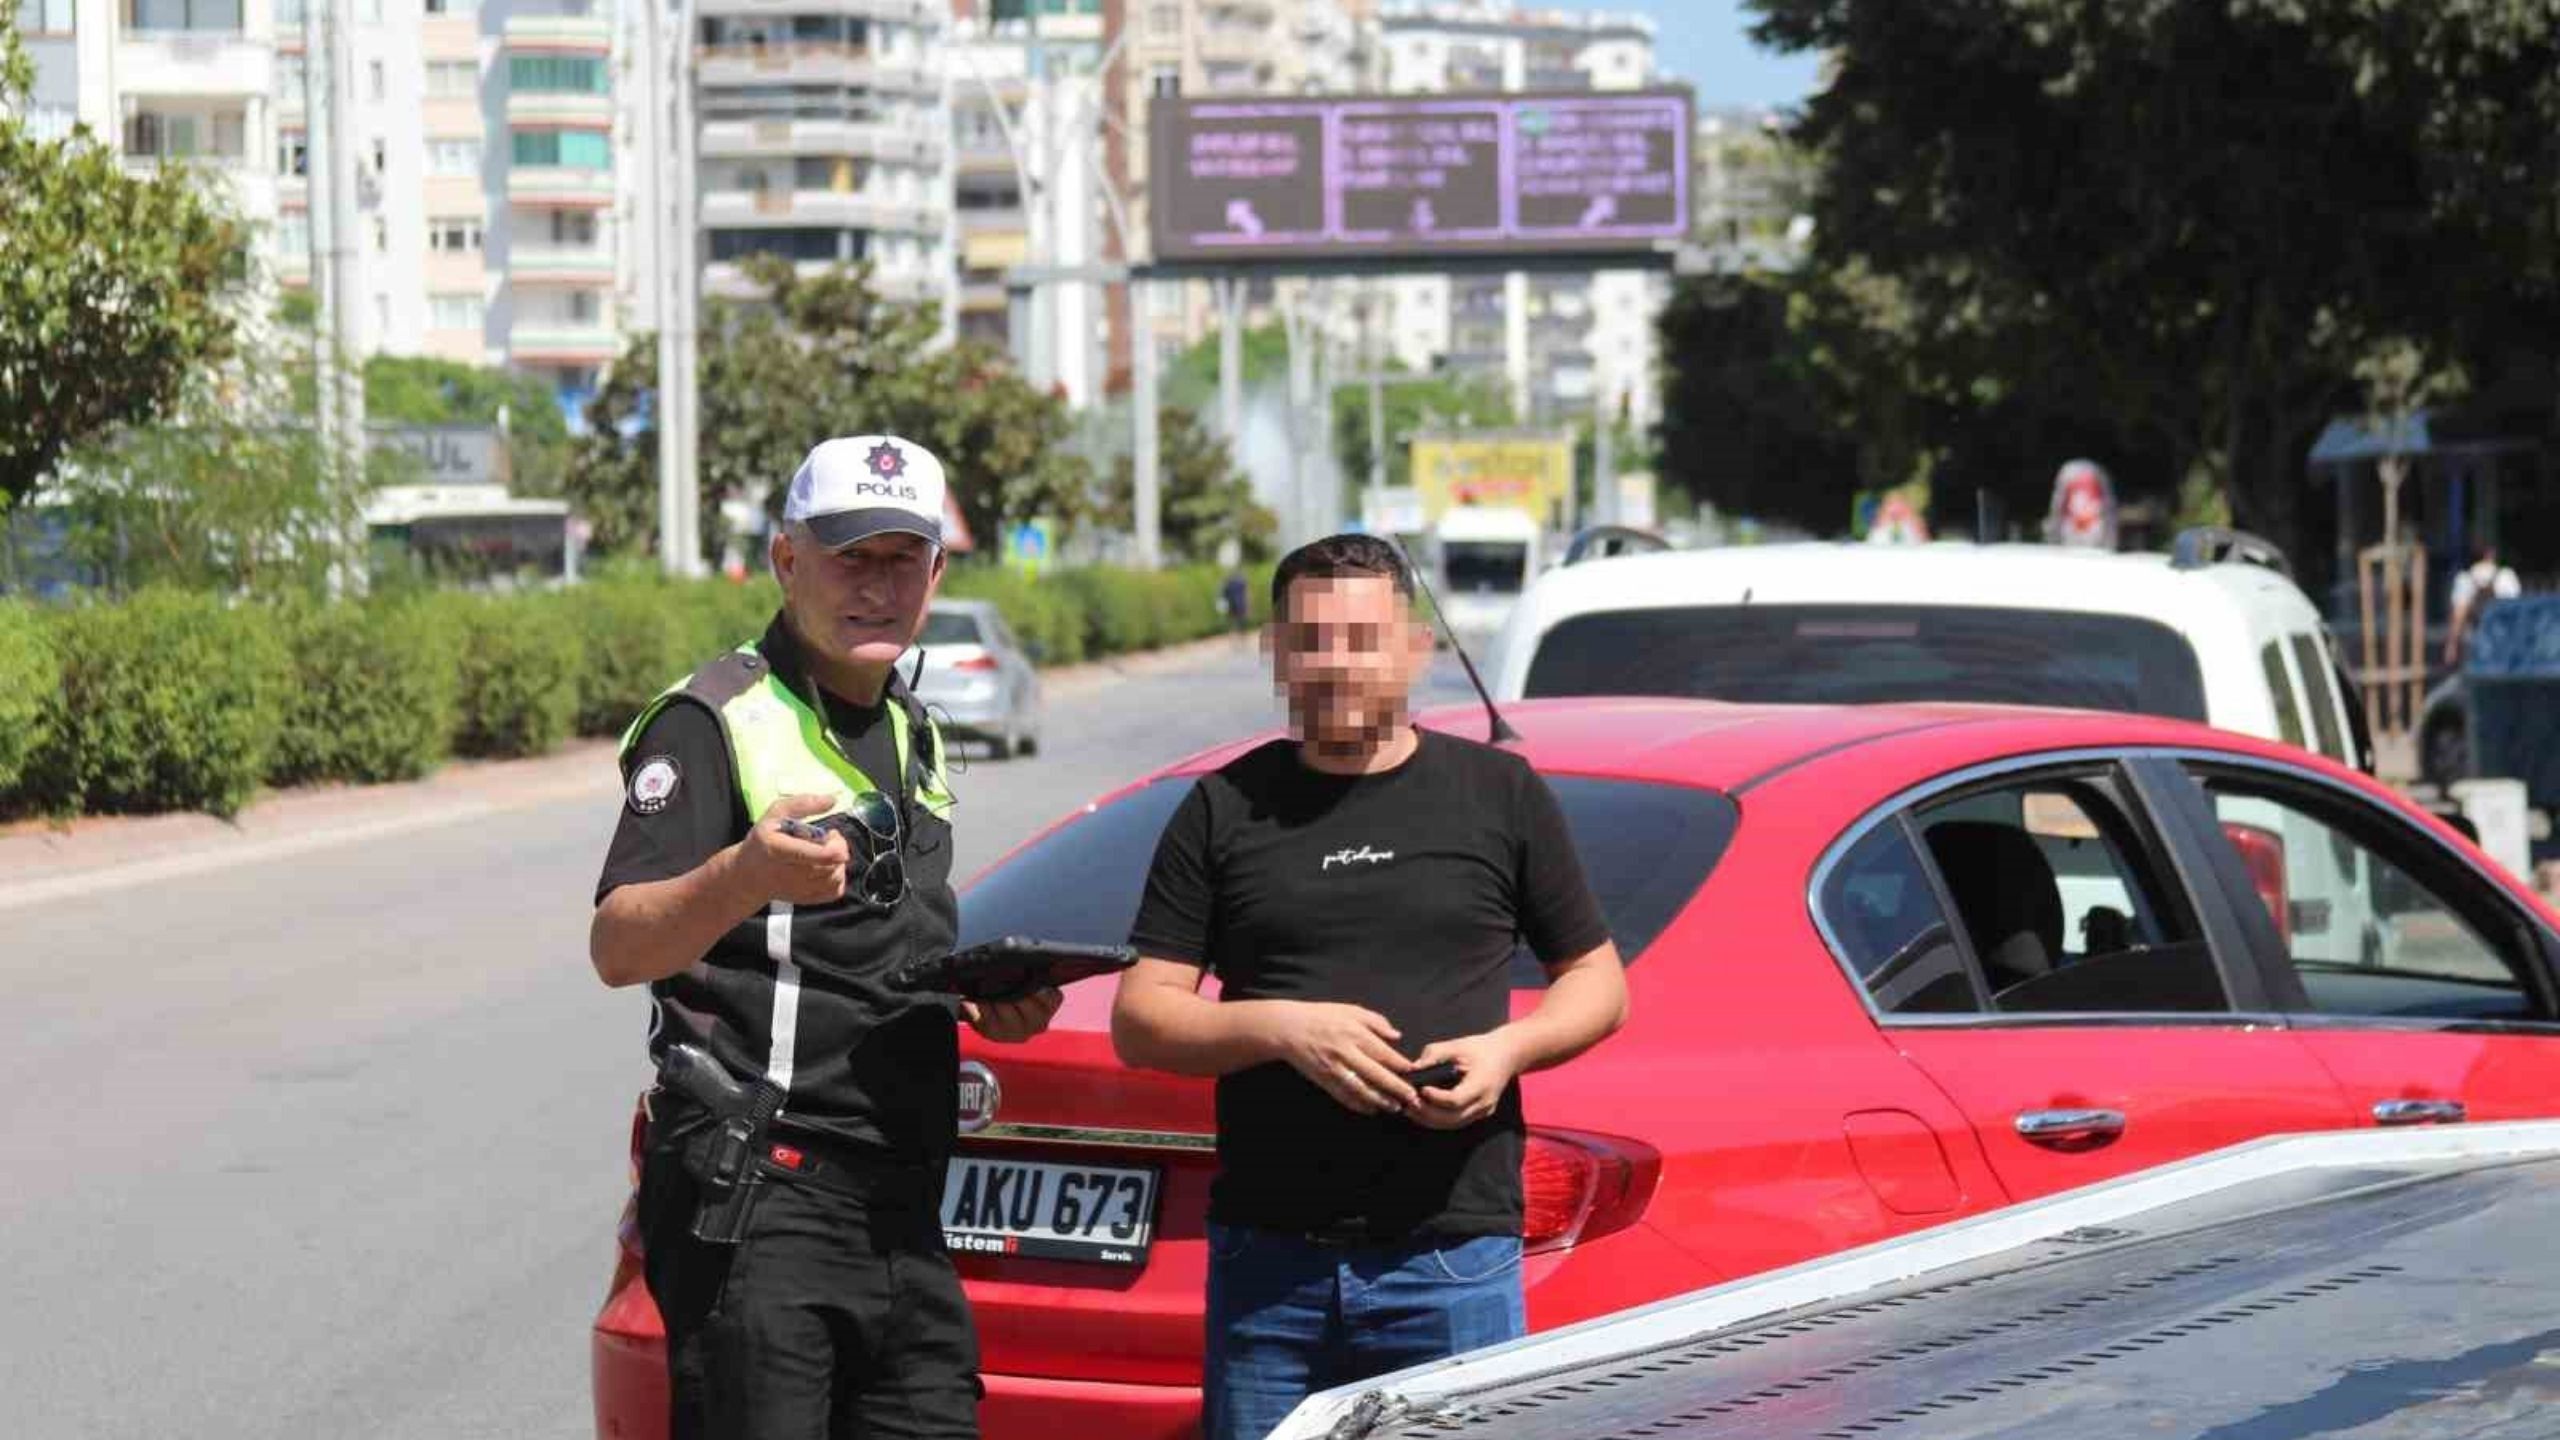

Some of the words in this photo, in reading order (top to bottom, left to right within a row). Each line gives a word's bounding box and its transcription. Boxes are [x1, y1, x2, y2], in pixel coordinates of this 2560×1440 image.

[958, 1082, 983, 1110] IAT
[951, 1164, 1044, 1232] AKU
[1052, 1171, 1144, 1240] 673
